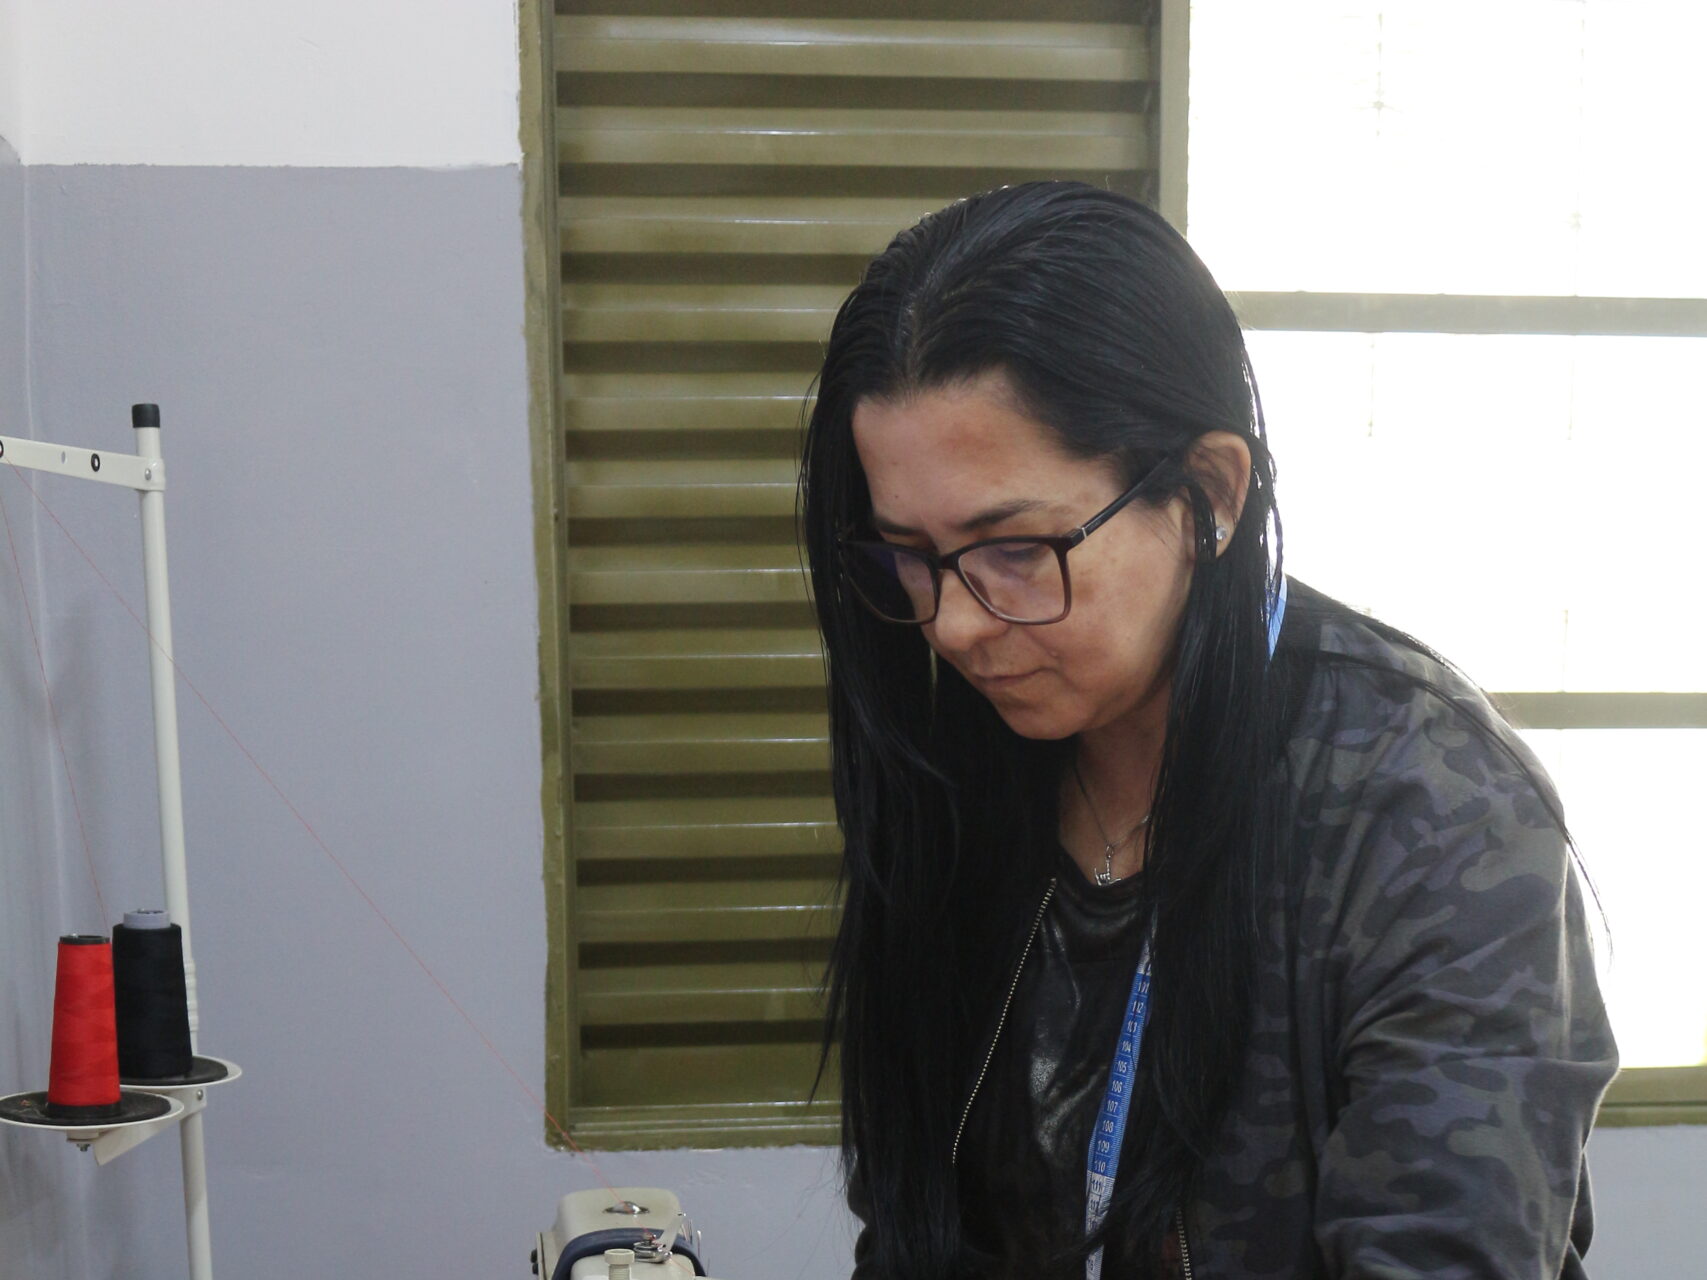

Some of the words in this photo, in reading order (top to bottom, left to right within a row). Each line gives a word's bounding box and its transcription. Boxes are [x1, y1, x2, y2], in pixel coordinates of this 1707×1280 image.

[1117, 1061, 1127, 1073] 105
[1112, 1080, 1122, 1093] 106
[1107, 1101, 1118, 1113] 107
[1102, 1120, 1114, 1133] 108
[1097, 1140, 1110, 1153] 109
[1094, 1160, 1106, 1173] 110
